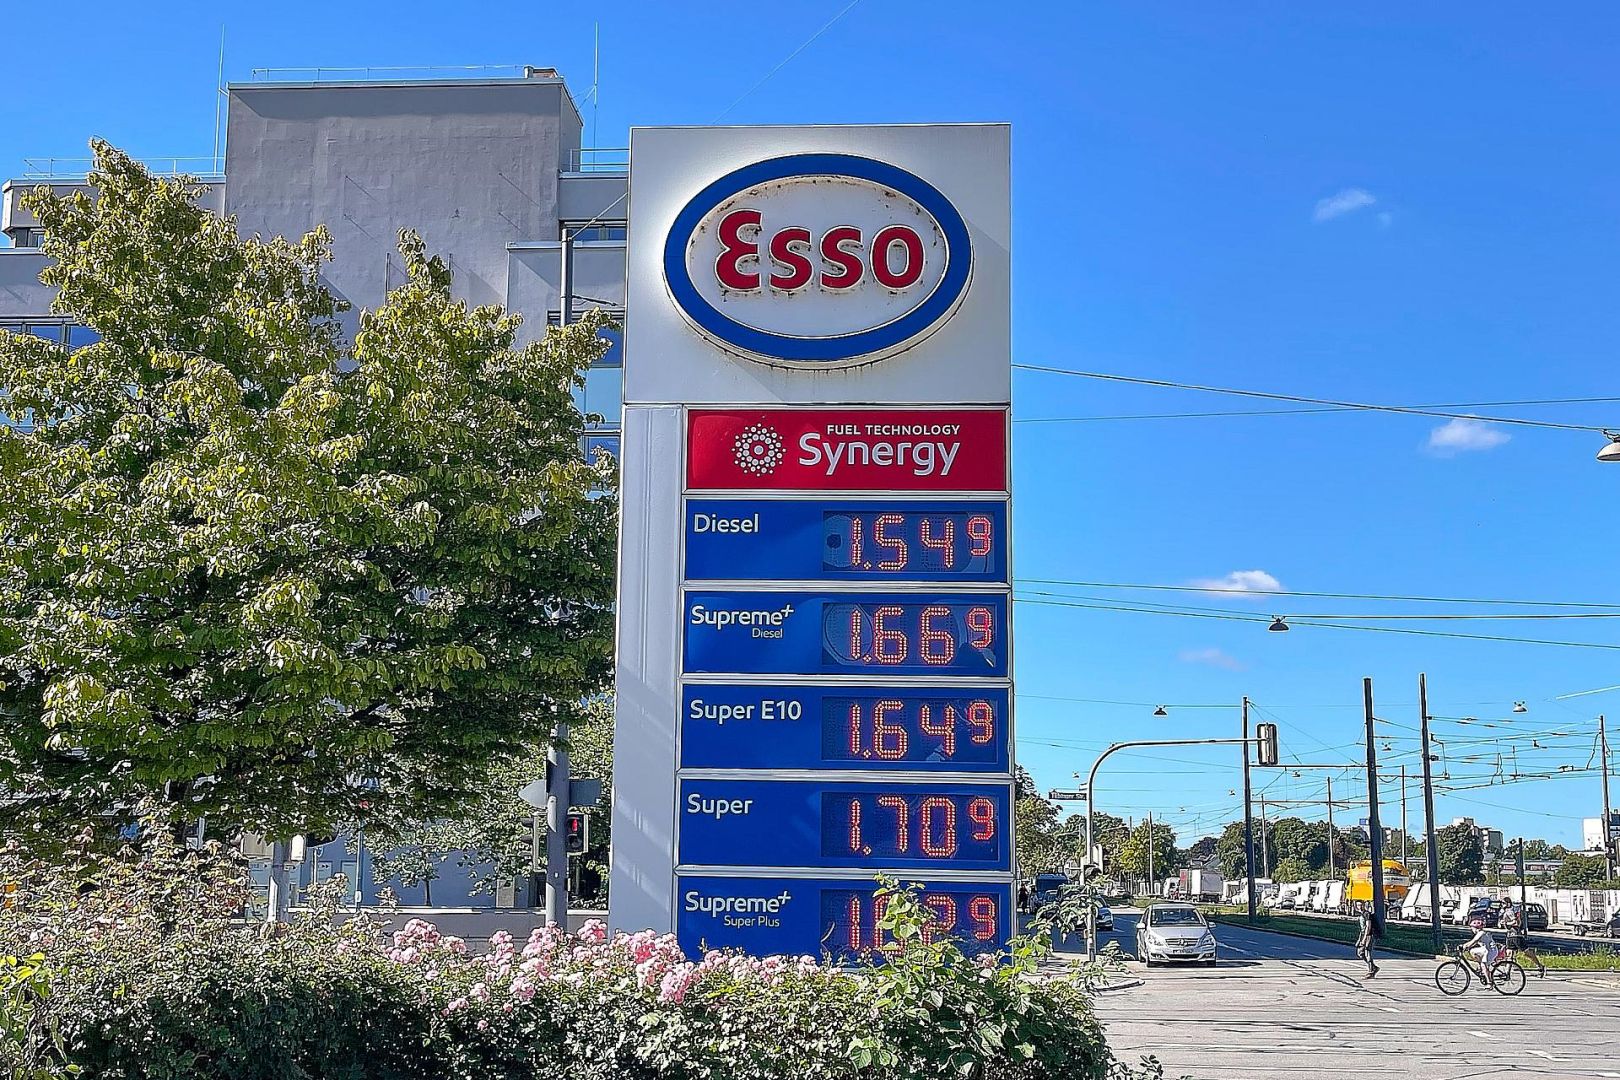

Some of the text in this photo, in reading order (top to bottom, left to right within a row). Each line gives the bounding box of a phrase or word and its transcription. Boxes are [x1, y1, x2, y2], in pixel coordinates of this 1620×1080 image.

[827, 424, 960, 435] FUEL TECHNOLOGY
[799, 432, 961, 476] Synergy
[693, 513, 759, 533] Diesel
[751, 627, 783, 639] Diesel
[690, 699, 802, 725] Super E10
[687, 793, 753, 819] Super
[724, 915, 780, 928] Super Plus
